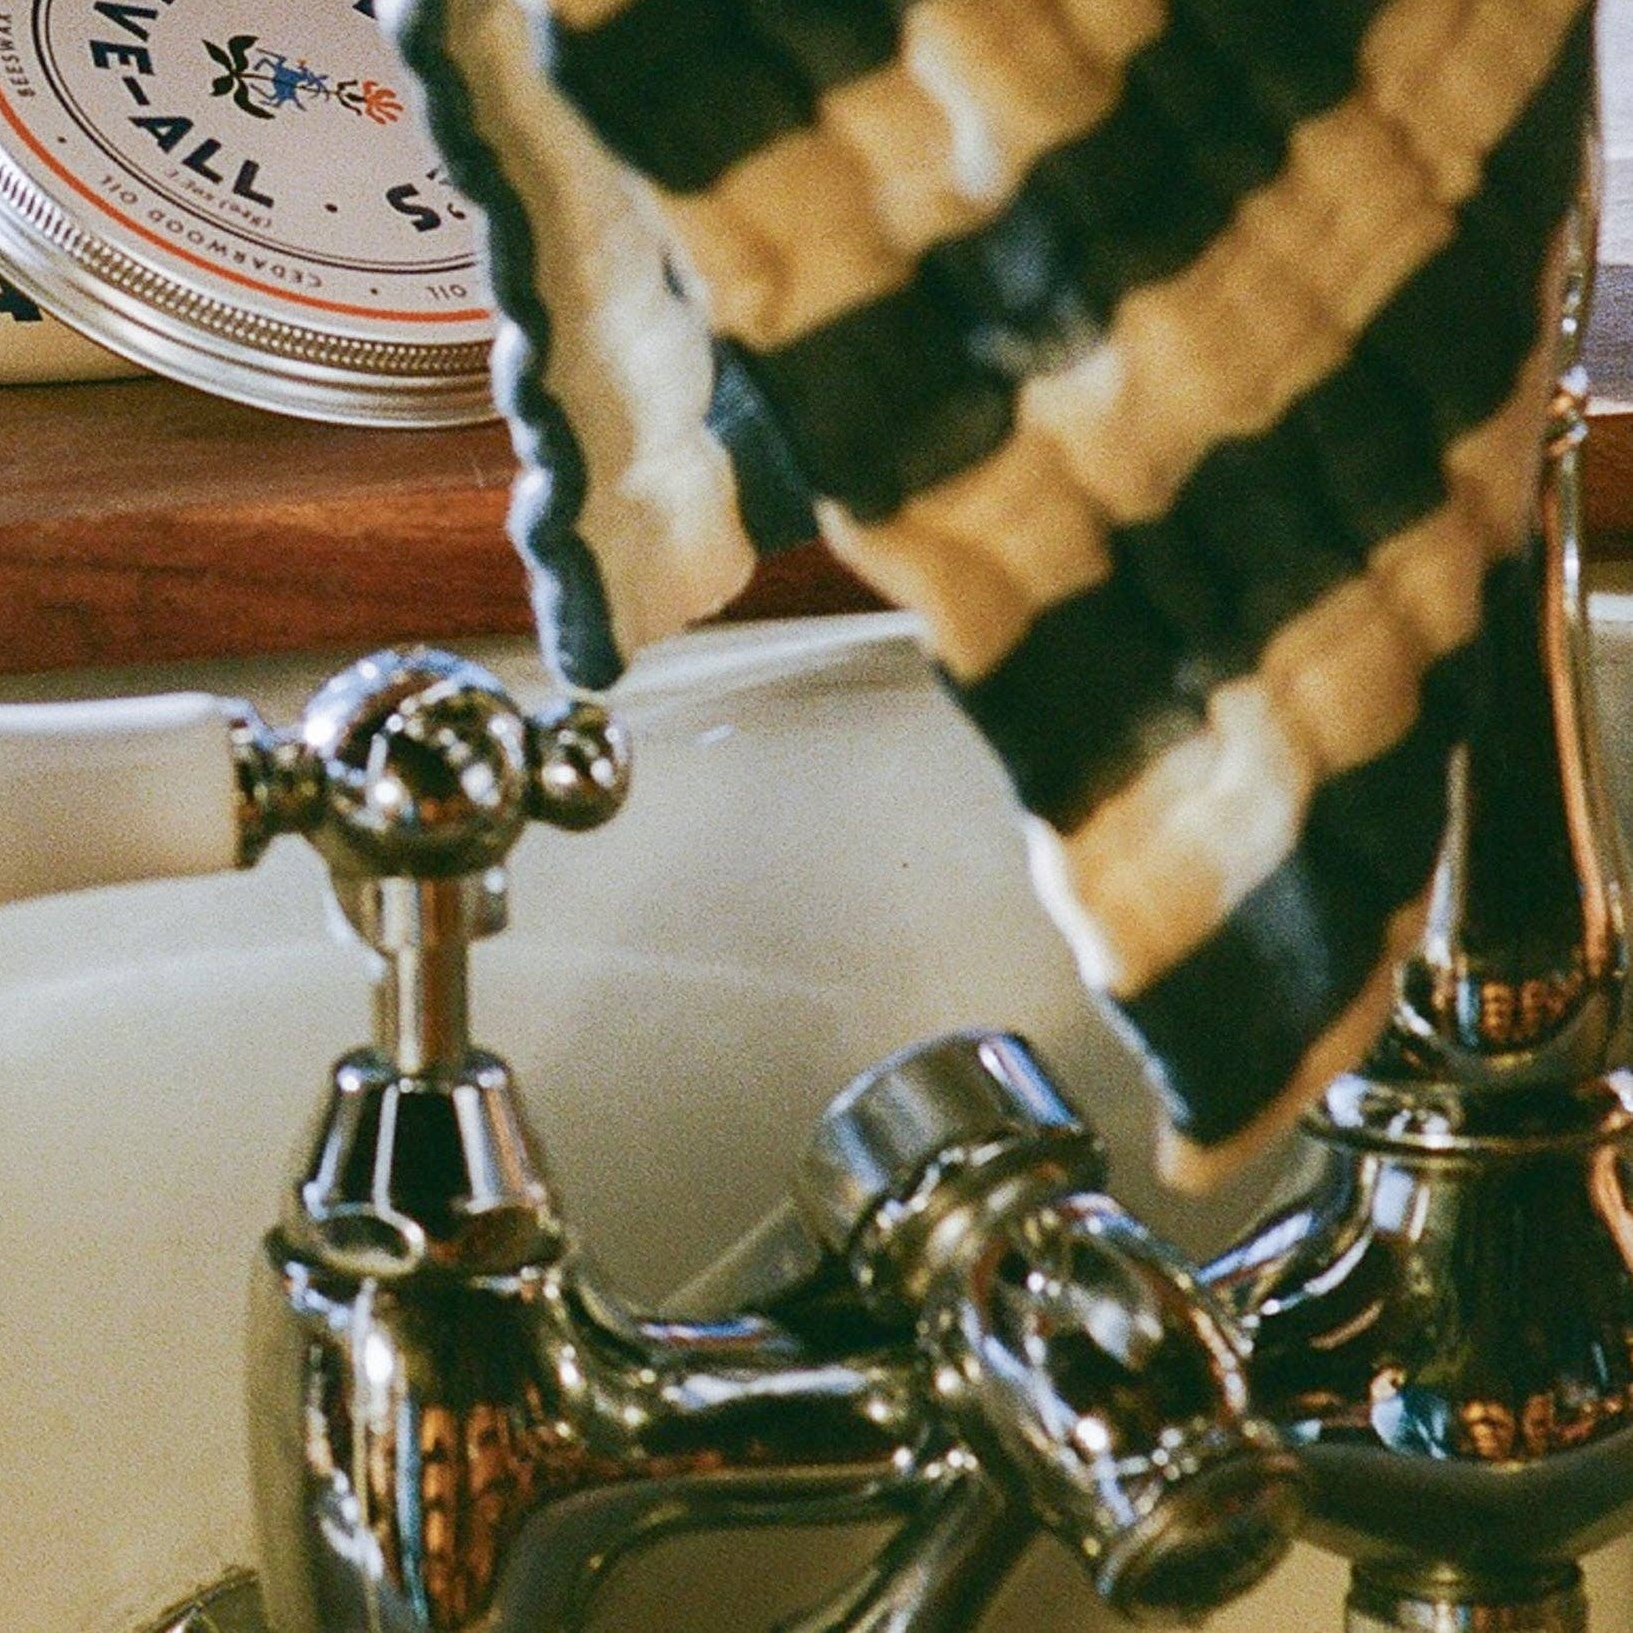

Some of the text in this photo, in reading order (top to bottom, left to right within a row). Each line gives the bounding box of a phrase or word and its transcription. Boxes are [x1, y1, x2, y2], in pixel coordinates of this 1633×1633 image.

[100, 174, 139, 206] OIL
[147, 208, 323, 288] CEDARWOOD
[425, 283, 468, 302] OIL
